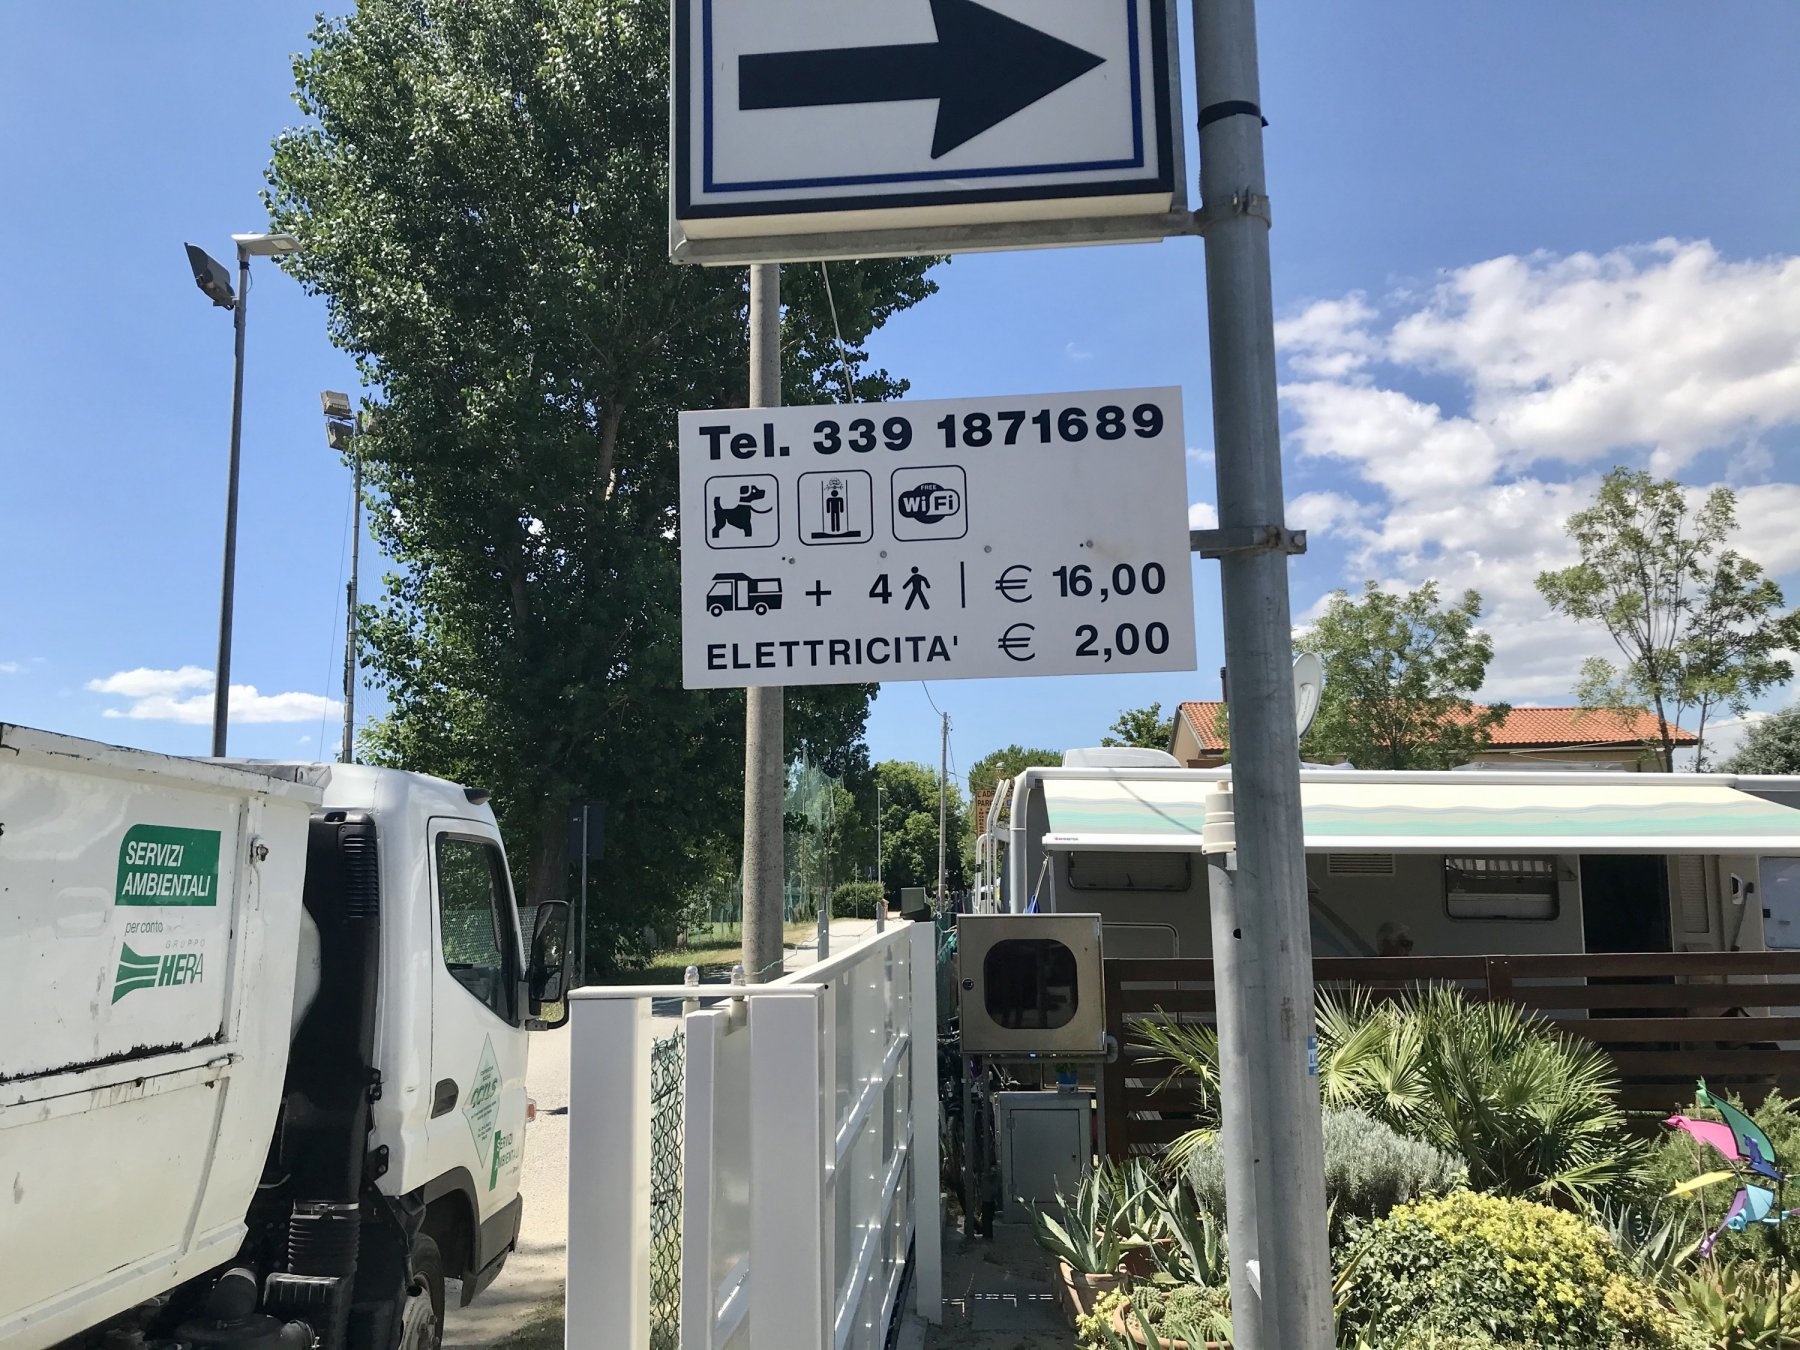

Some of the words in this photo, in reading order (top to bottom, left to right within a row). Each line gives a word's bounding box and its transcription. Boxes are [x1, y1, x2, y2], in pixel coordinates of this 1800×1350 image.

[699, 423, 790, 460] Tel.
[813, 416, 913, 454] 339
[937, 403, 1164, 448] 1871689
[869, 574, 892, 604] 4
[995, 564, 1033, 603] €
[1052, 562, 1166, 603] 16,00
[707, 635, 958, 670] ELETTRICITA'
[998, 622, 1036, 662] €
[1075, 621, 1170, 663] 2,00
[126, 841, 184, 867] SERVIZI
[122, 872, 210, 896] AMBIENTALI
[125, 922, 140, 936] per
[140, 920, 164, 934] conto
[165, 938, 206, 949] GRUPPO
[158, 953, 204, 986] HERA
[496, 1133, 513, 1151] SERVIZI
